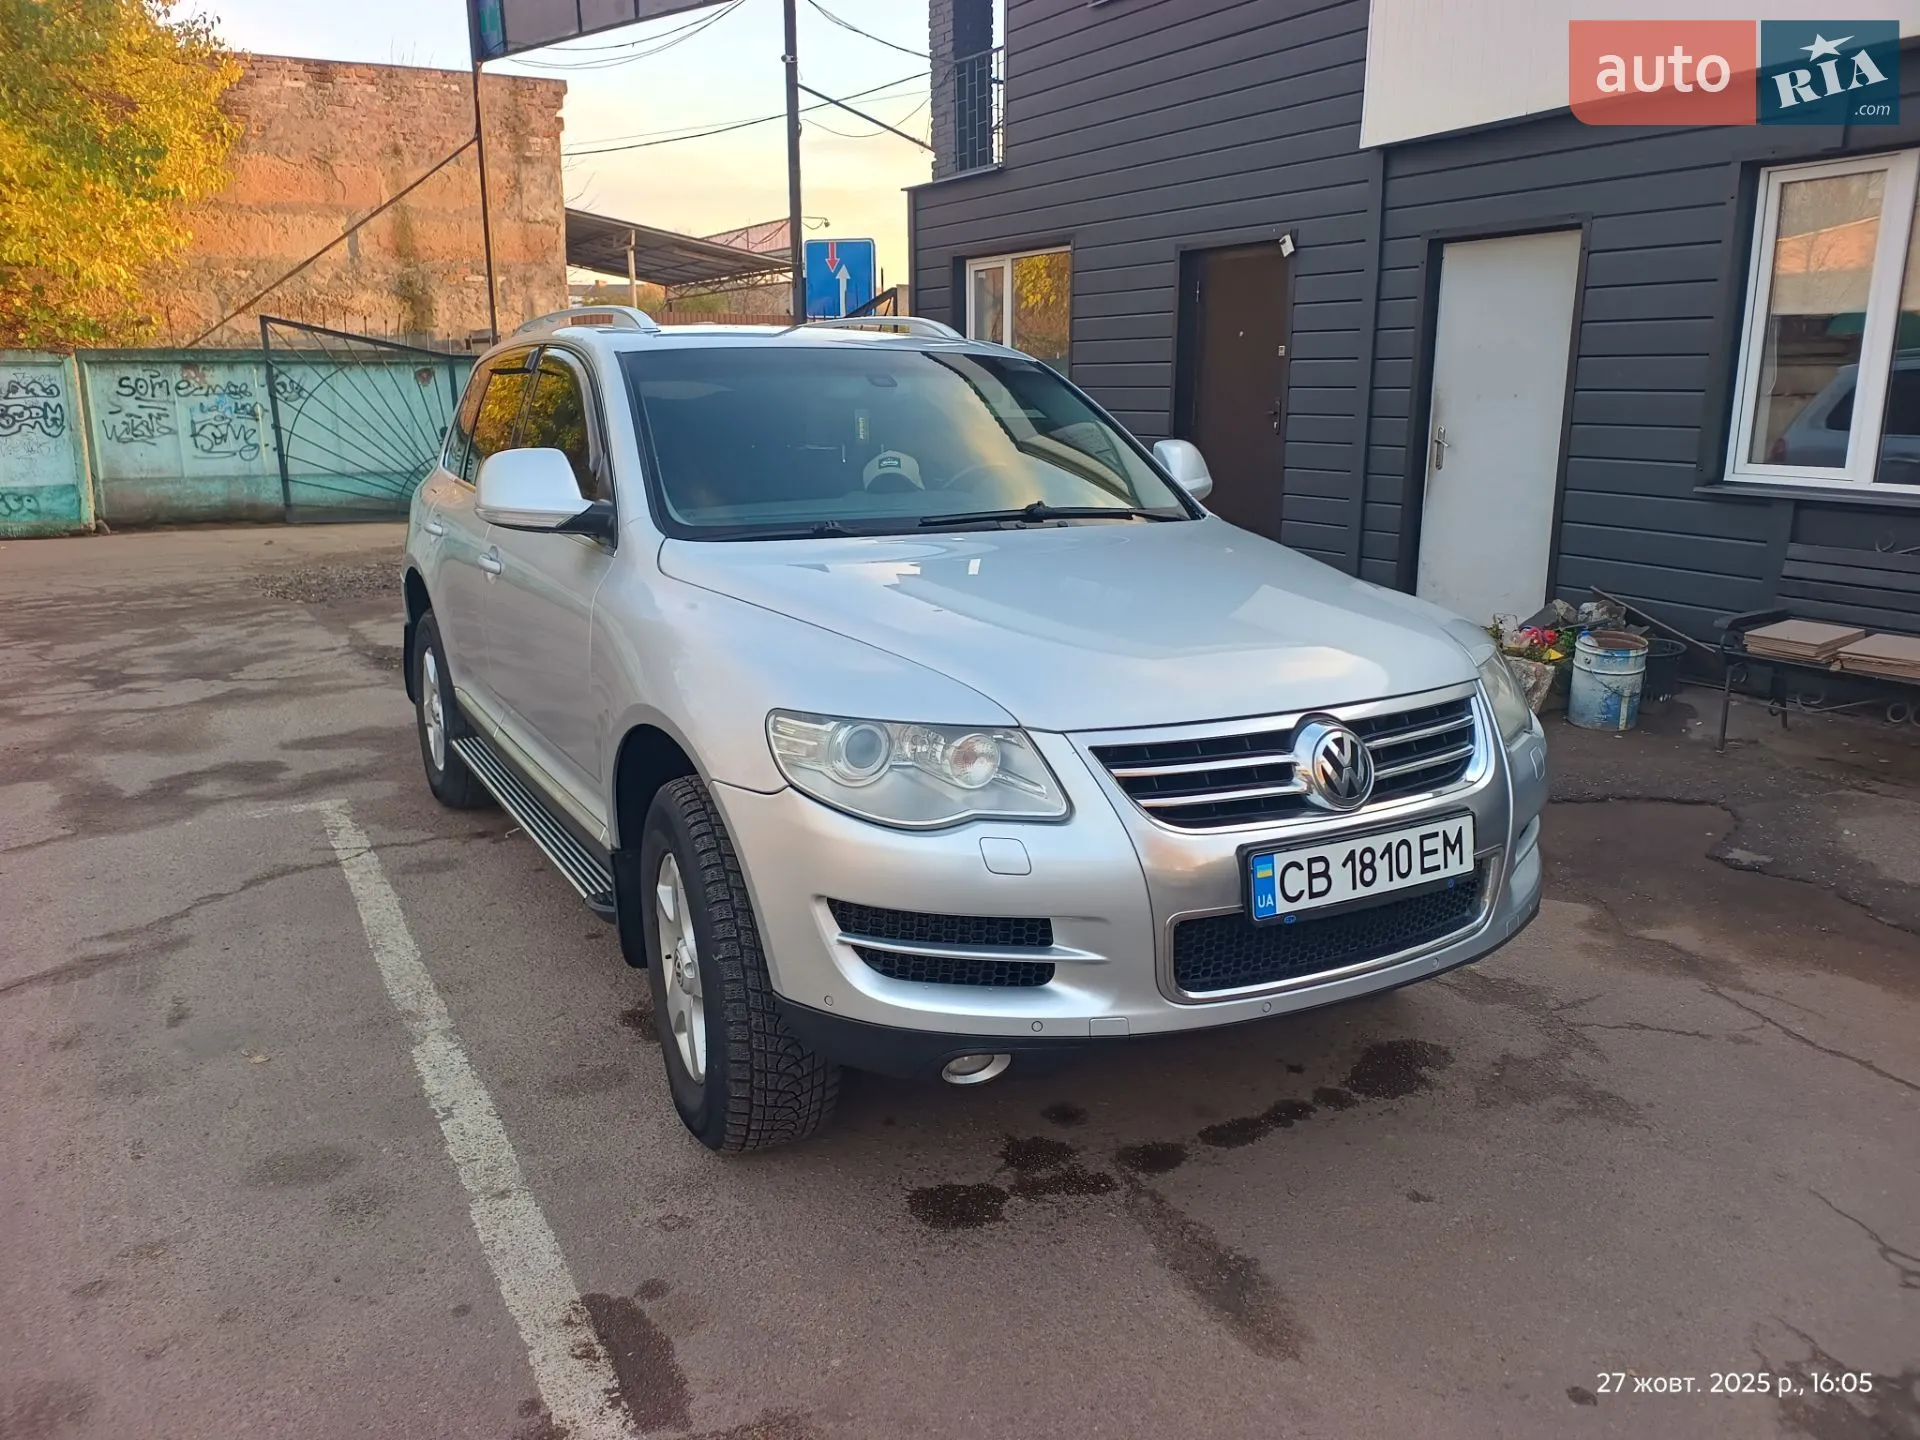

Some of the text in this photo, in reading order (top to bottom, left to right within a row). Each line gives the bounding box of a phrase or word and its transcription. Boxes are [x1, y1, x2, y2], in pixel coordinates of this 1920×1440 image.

[1279, 825, 1465, 903] CB 1810 EM
[1257, 893, 1275, 908] UA
